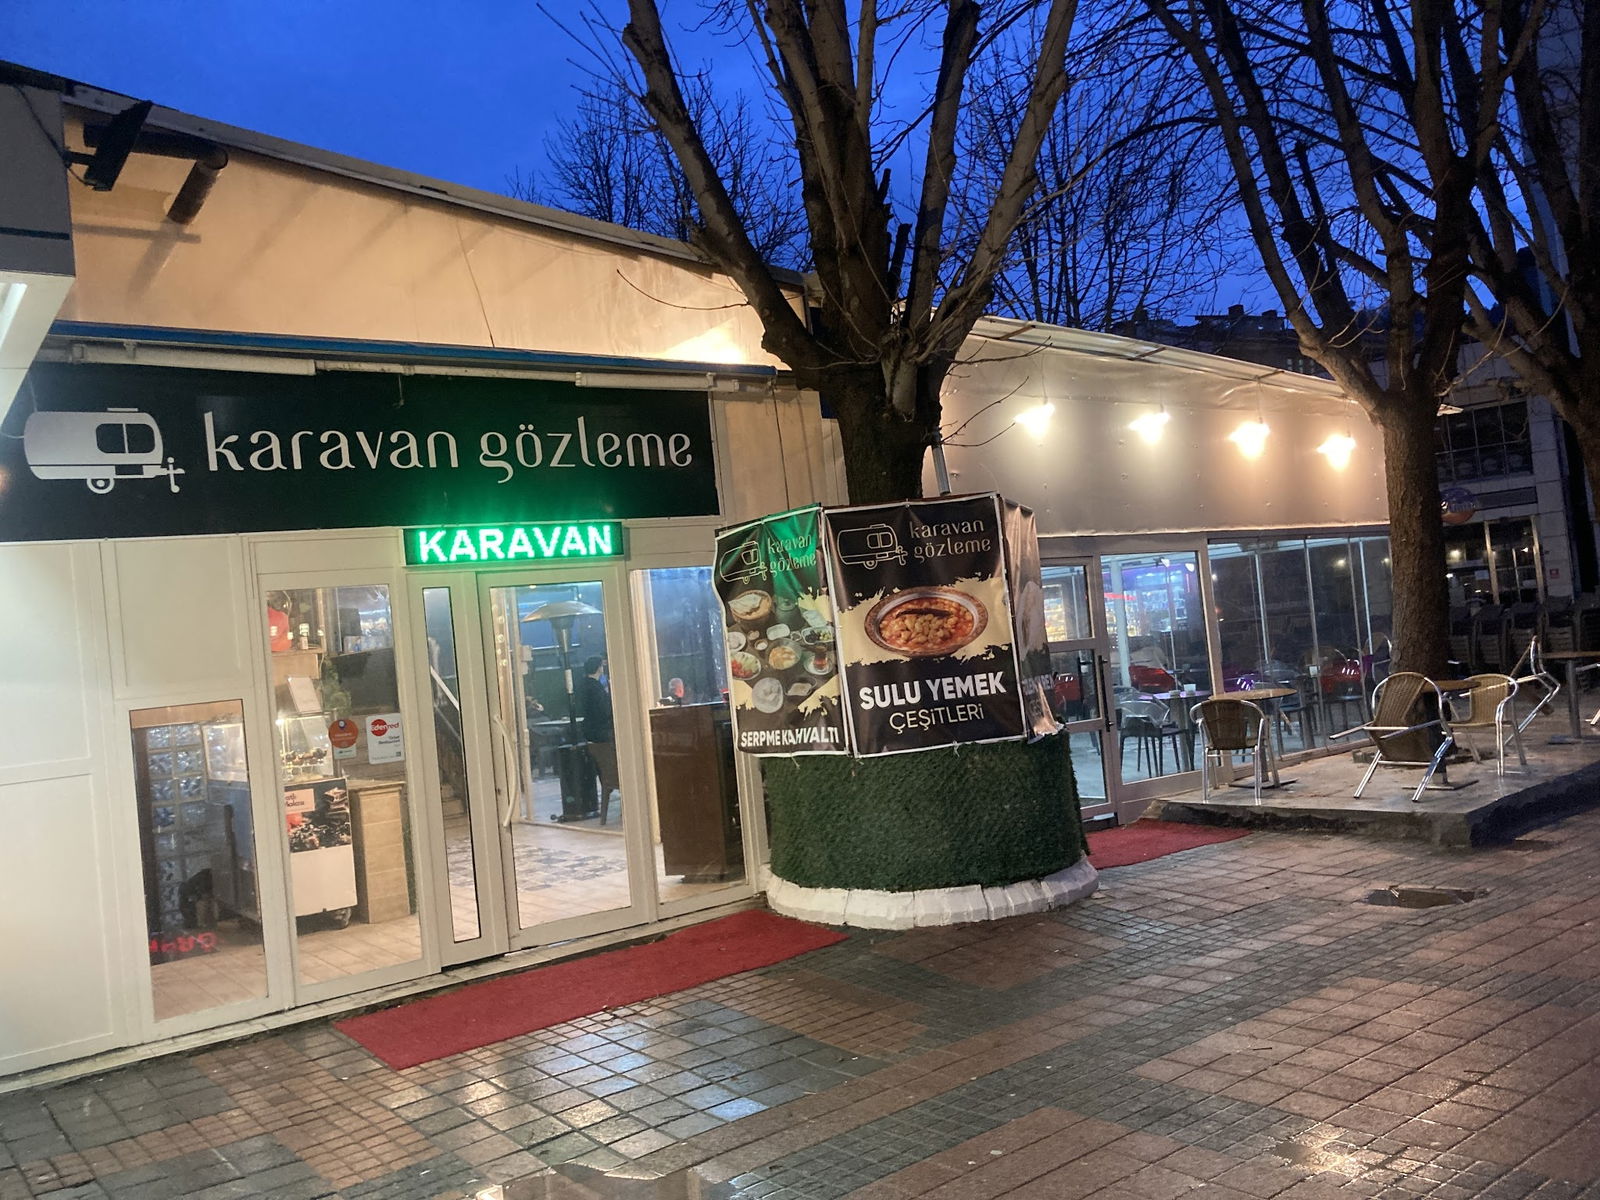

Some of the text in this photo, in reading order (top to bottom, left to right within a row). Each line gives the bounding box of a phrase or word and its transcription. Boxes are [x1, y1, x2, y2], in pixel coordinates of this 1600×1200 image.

[204, 410, 693, 484] karavan gözleme
[418, 525, 613, 563] KARAVAN
[909, 520, 985, 539] karavan
[914, 536, 991, 563] gözleme
[859, 679, 921, 711] SULU
[923, 671, 1006, 701] YEMEK
[741, 727, 839, 748] SERPME KAHVALTI
